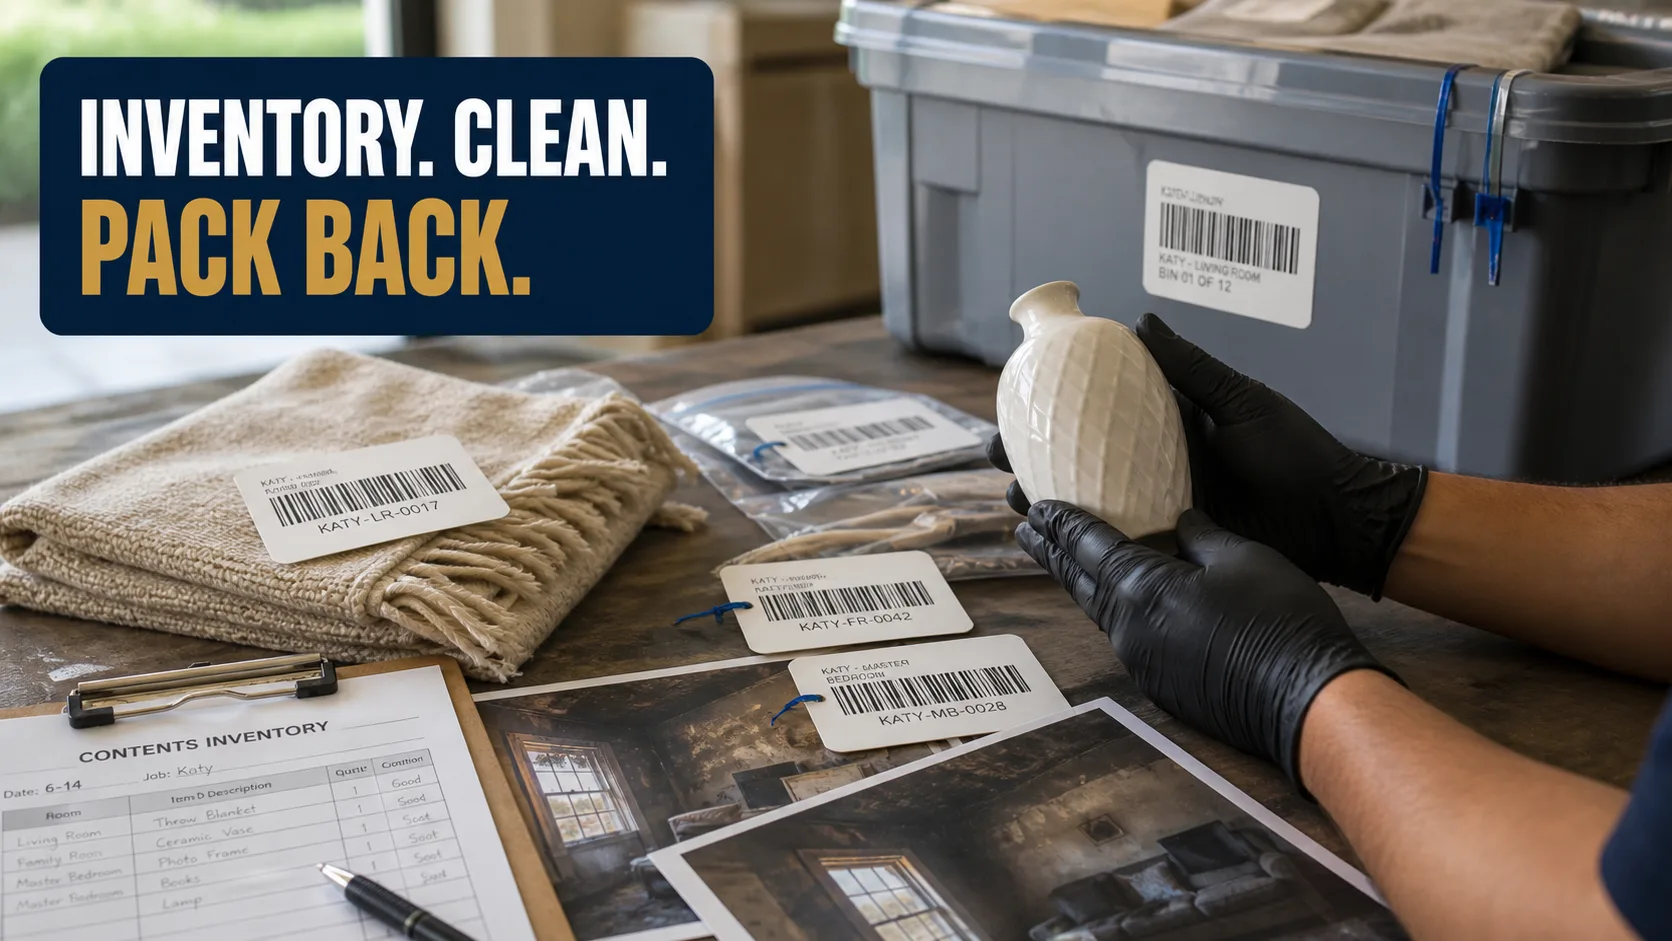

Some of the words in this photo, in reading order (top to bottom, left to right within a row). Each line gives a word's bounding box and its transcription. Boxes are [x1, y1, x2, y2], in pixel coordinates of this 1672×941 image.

[1158, 253, 1187, 267] KATY
[1158, 266, 1179, 281] BIN
[1181, 271, 1194, 285] 01
[1197, 276, 1214, 288] OF
[1218, 279, 1232, 293] 12
[318, 500, 439, 534] KATY-LR-0017
[750, 576, 779, 585] KATY
[799, 611, 913, 632] KATY-FR-0042
[821, 664, 850, 675] KATY
[79, 738, 199, 764] CONTENTS
[206, 720, 329, 748] INVENTORY
[143, 769, 171, 782] Job:
[176, 763, 214, 777] Katy
[3, 787, 39, 799] Date:
[45, 780, 82, 794] 6-14
[45, 809, 82, 821] Room
[153, 816, 197, 828] Throw
[206, 804, 257, 821] Blanket
[155, 833, 213, 848] Ceramic
[222, 825, 255, 837] Vase
[158, 854, 198, 868] Photo
